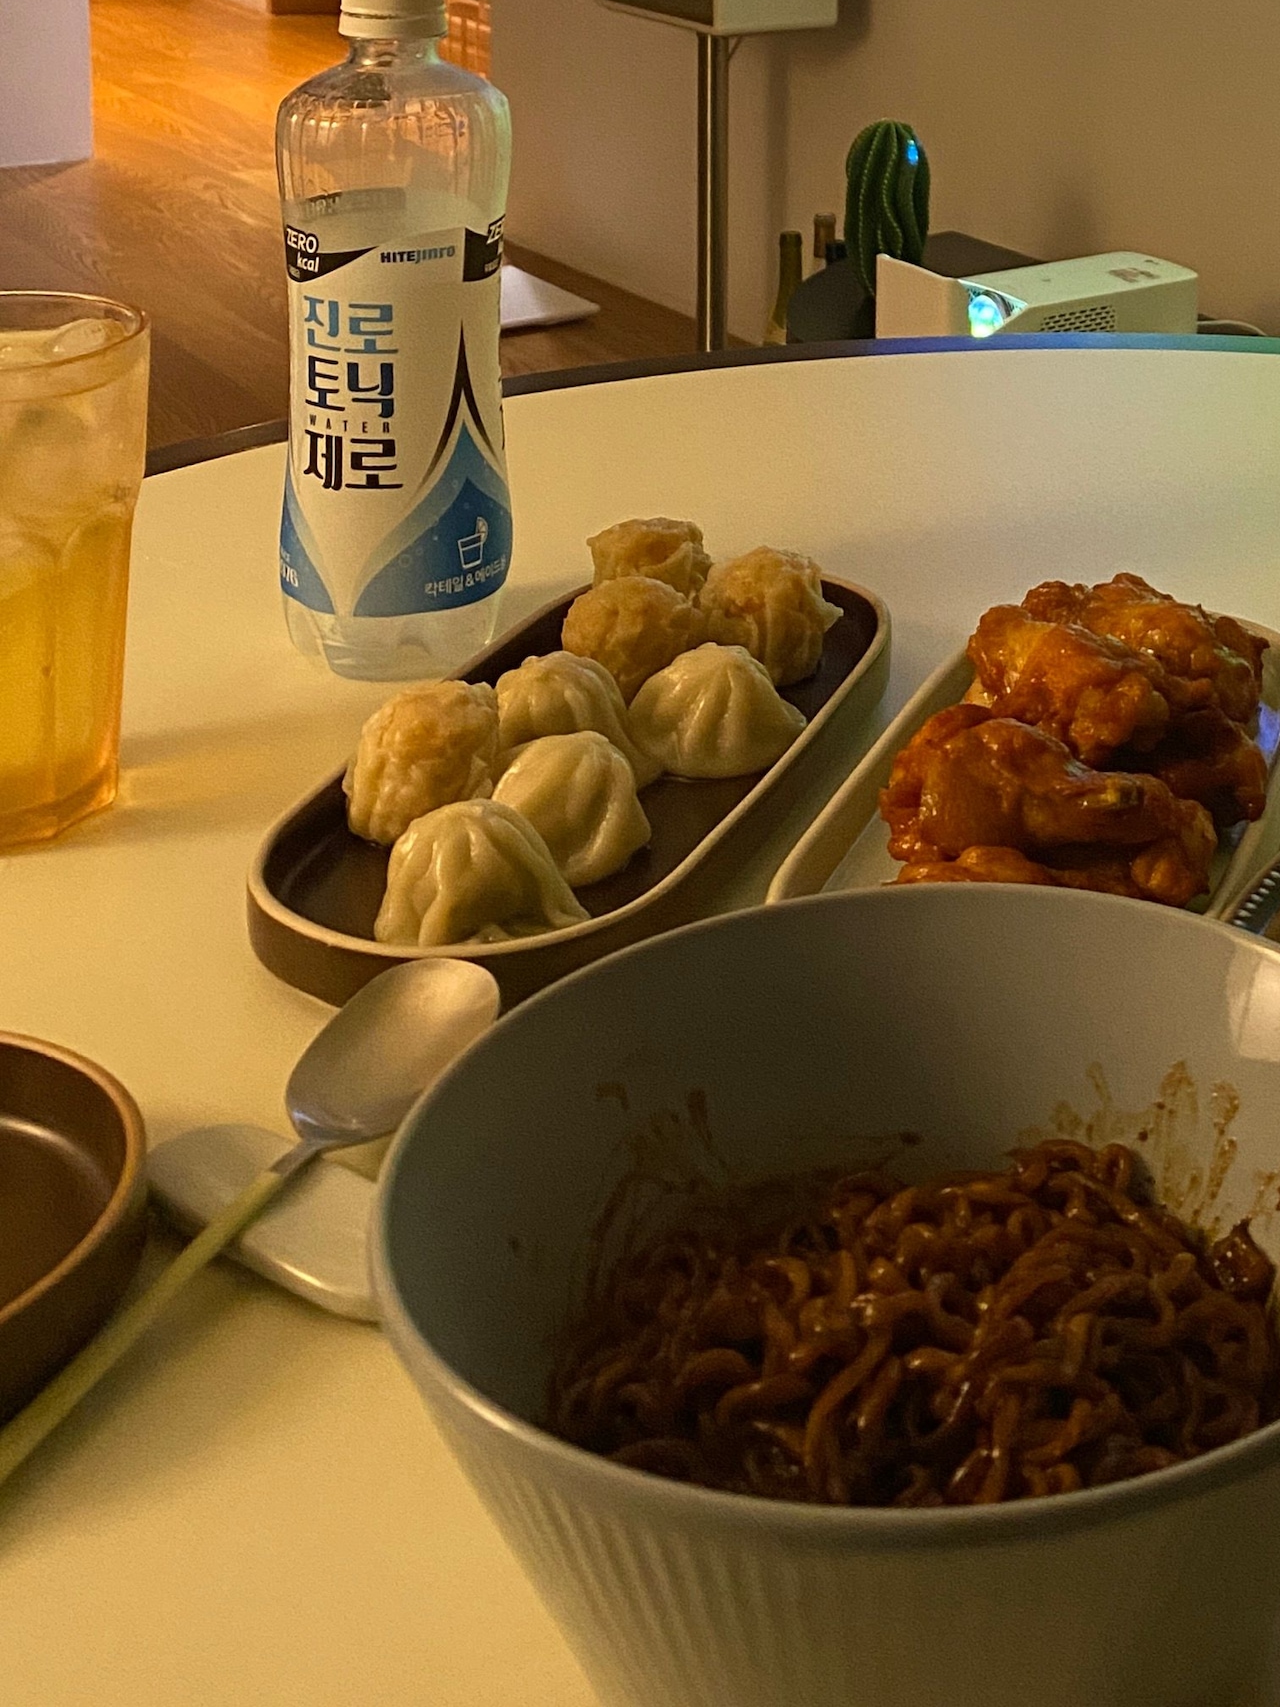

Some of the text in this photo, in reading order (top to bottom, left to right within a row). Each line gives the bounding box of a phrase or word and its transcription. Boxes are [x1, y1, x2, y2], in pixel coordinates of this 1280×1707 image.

[286, 226, 317, 254] ZERO
[297, 251, 320, 273] kcal
[304, 295, 399, 354] 진로
[305, 355, 395, 419] 토닉
[309, 414, 390, 434] WATER
[303, 429, 404, 491] 제로
